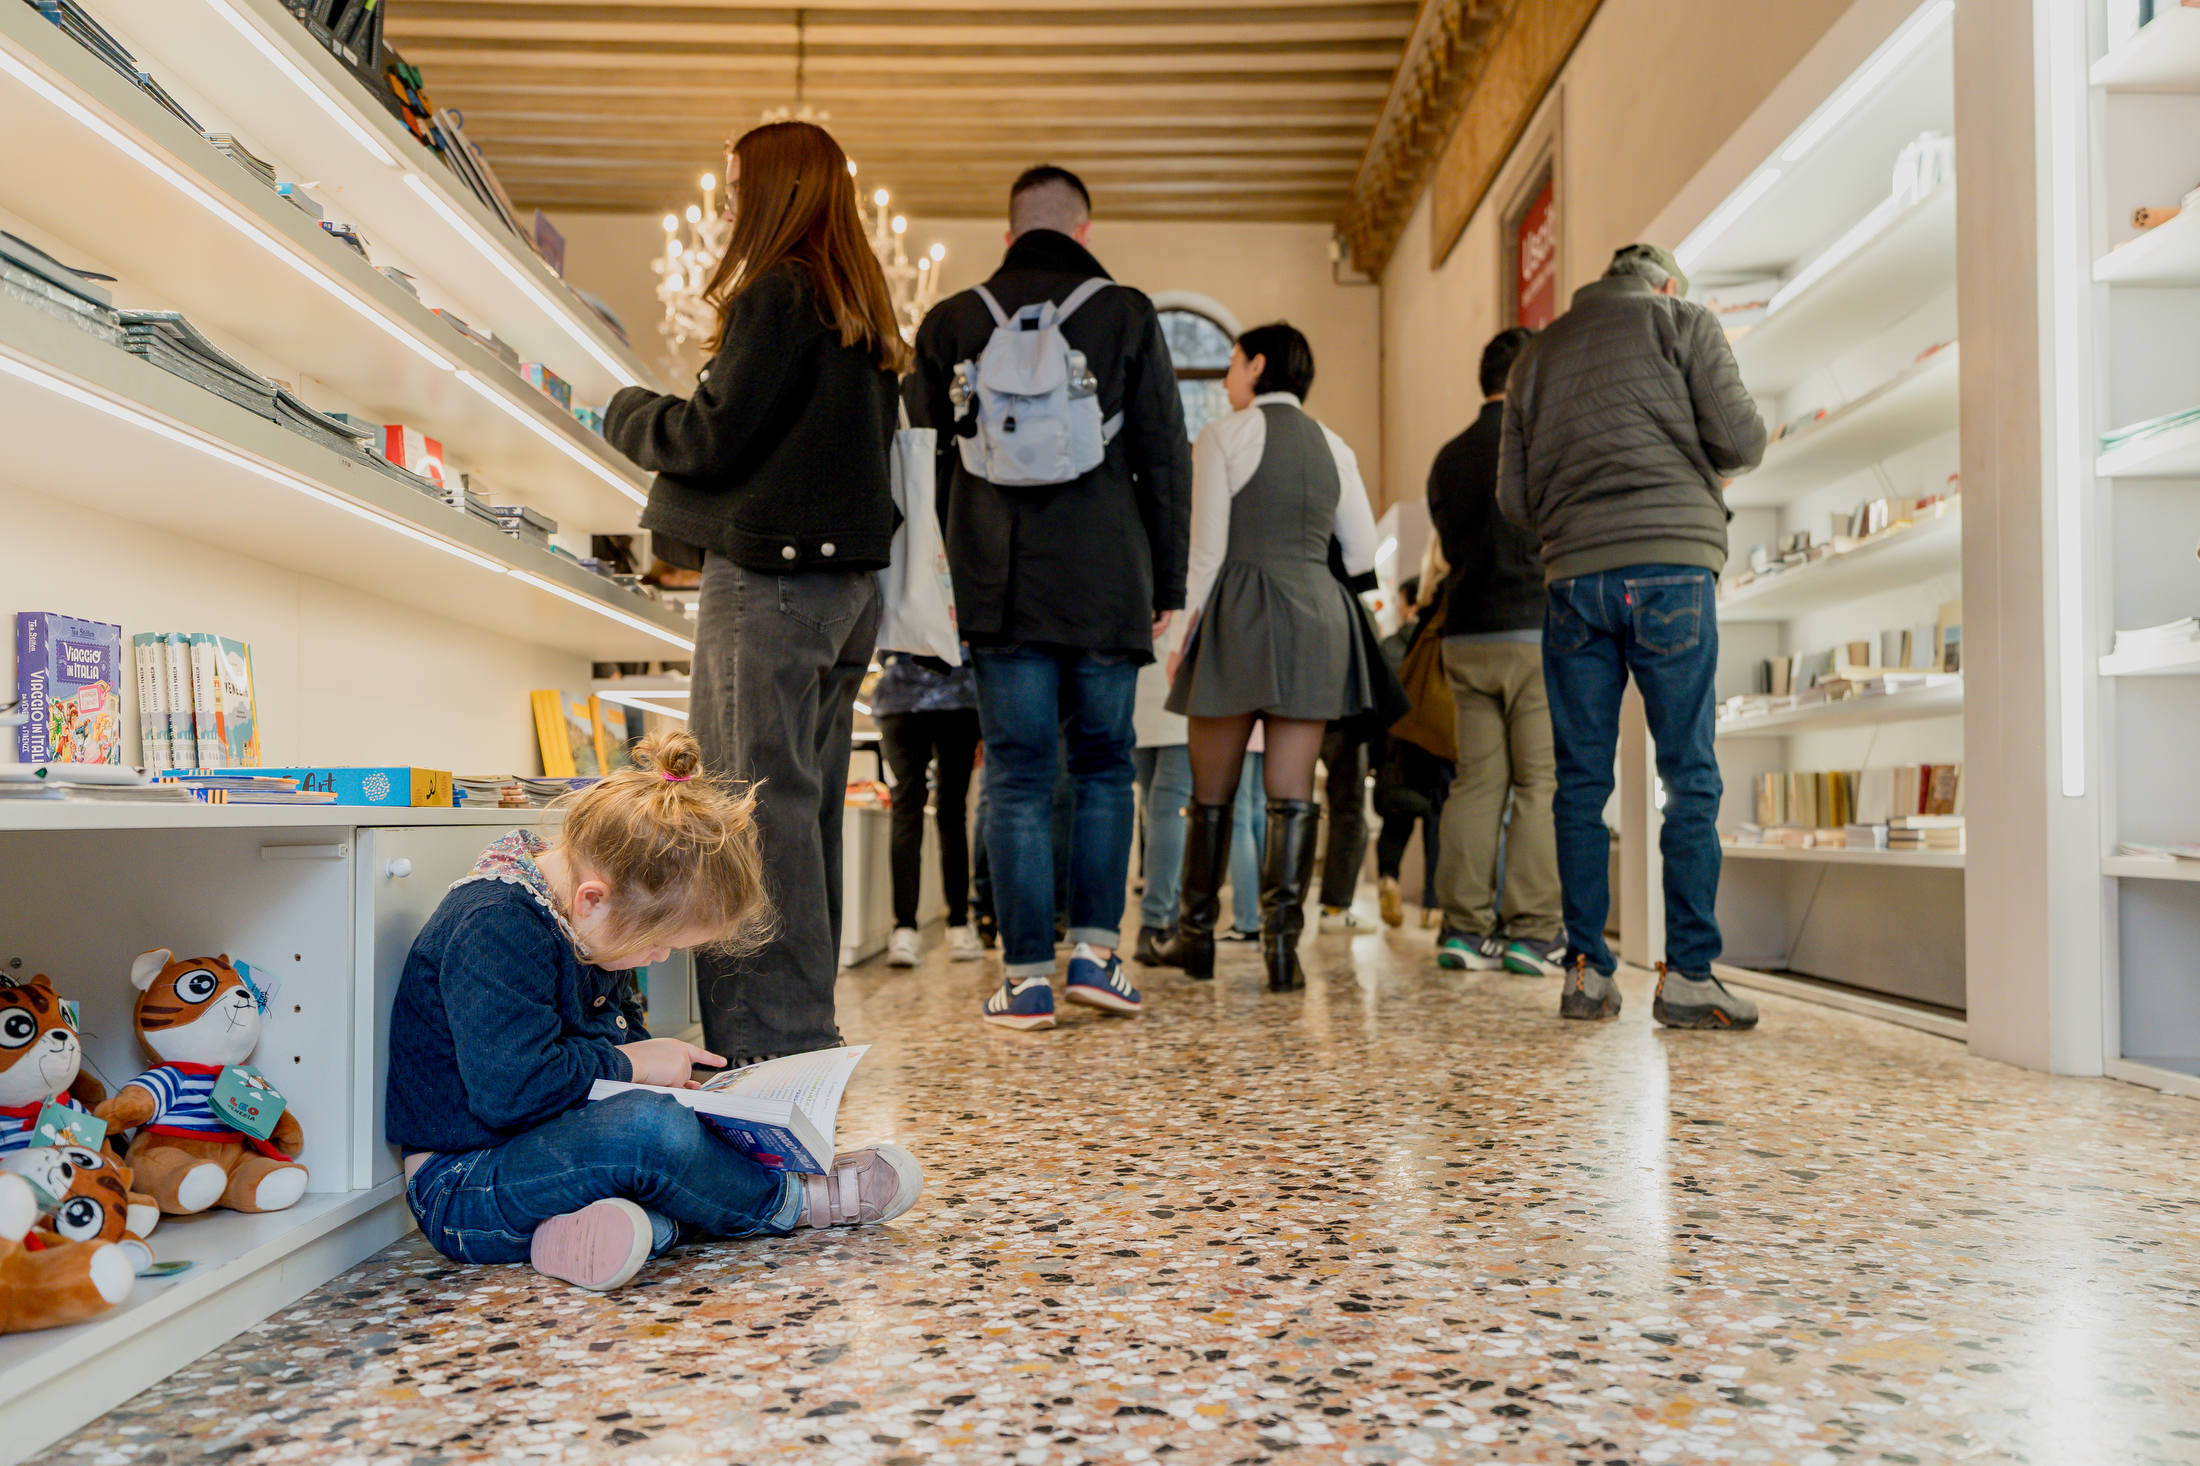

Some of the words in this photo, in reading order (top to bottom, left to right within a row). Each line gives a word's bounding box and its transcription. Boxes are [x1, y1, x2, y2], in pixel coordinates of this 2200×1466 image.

[30, 670, 45, 721] VIAGGIO
[31, 723, 43, 733] IN
[31, 735, 45, 764] ITALI
[302, 772, 337, 793] Art
[230, 1096, 259, 1116] LEO
